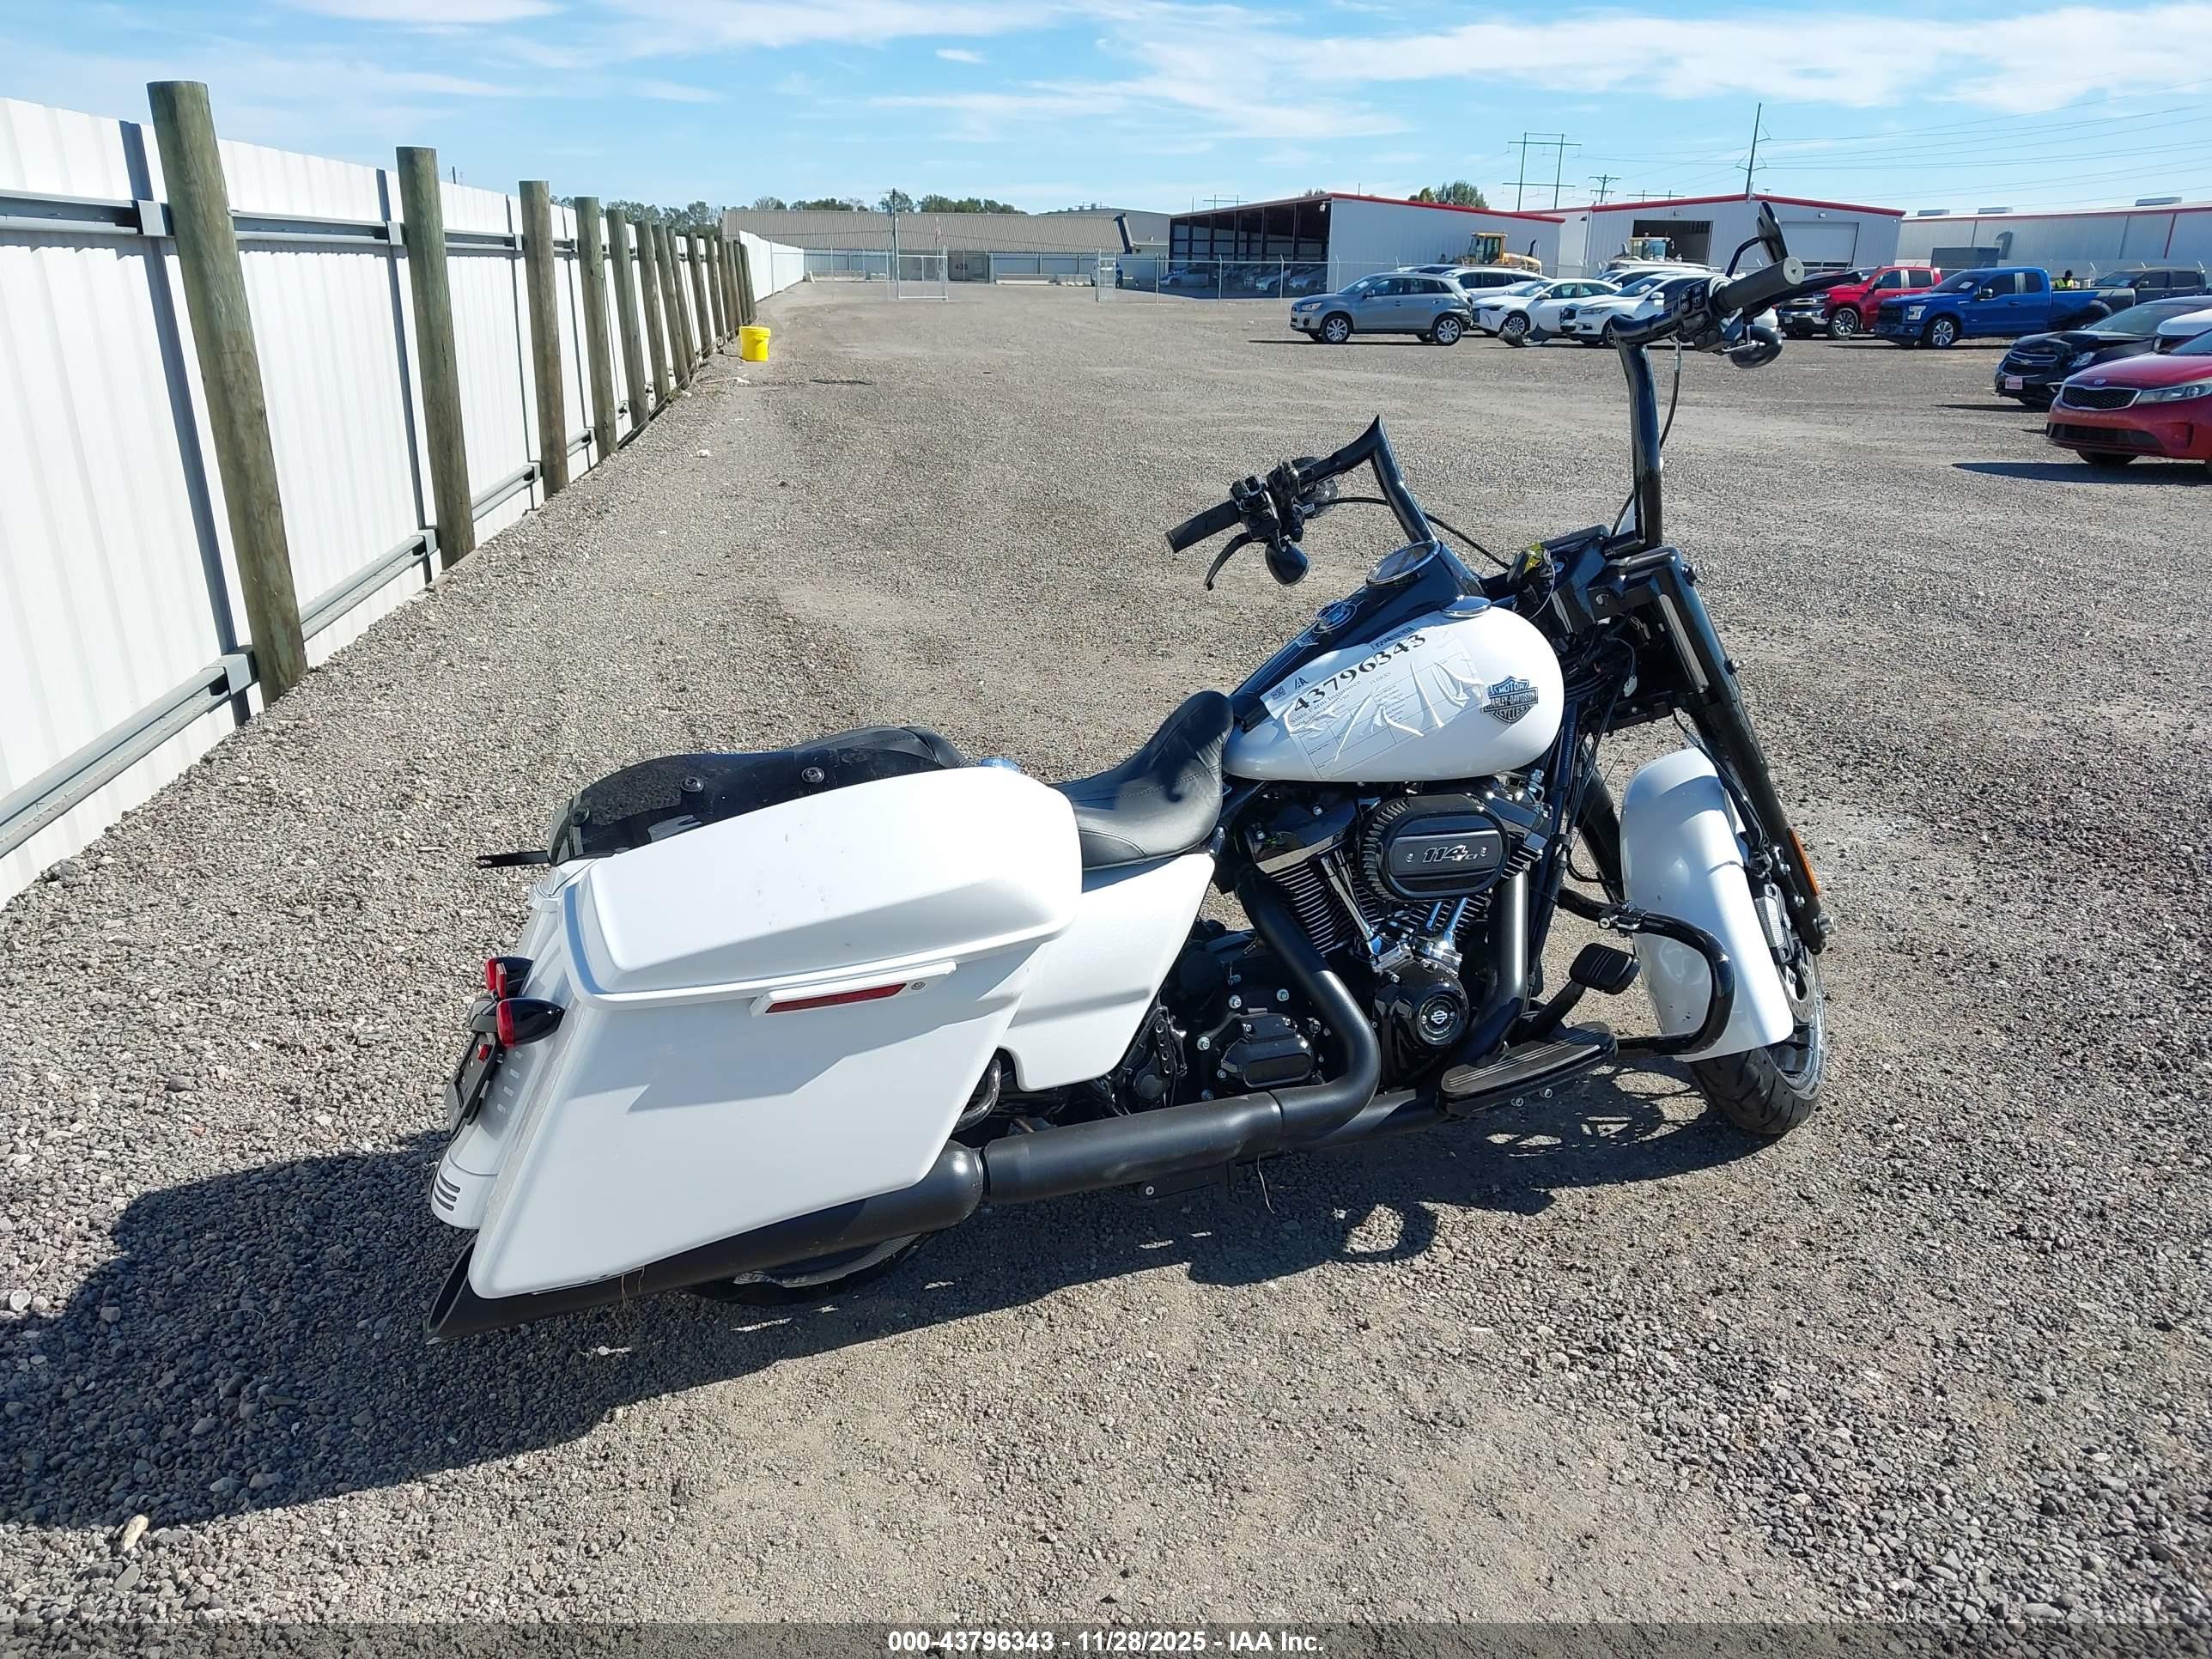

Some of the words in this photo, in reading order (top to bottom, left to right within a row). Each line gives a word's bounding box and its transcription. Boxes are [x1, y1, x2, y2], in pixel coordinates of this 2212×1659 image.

[1294, 634, 1426, 712] 43796343
[1498, 681, 1524, 694] MOTOR
[1290, 710, 1308, 725] State
[1308, 699, 1328, 714] Farm
[1328, 679, 1362, 702] Insurance
[1498, 705, 1525, 719] CYCLES
